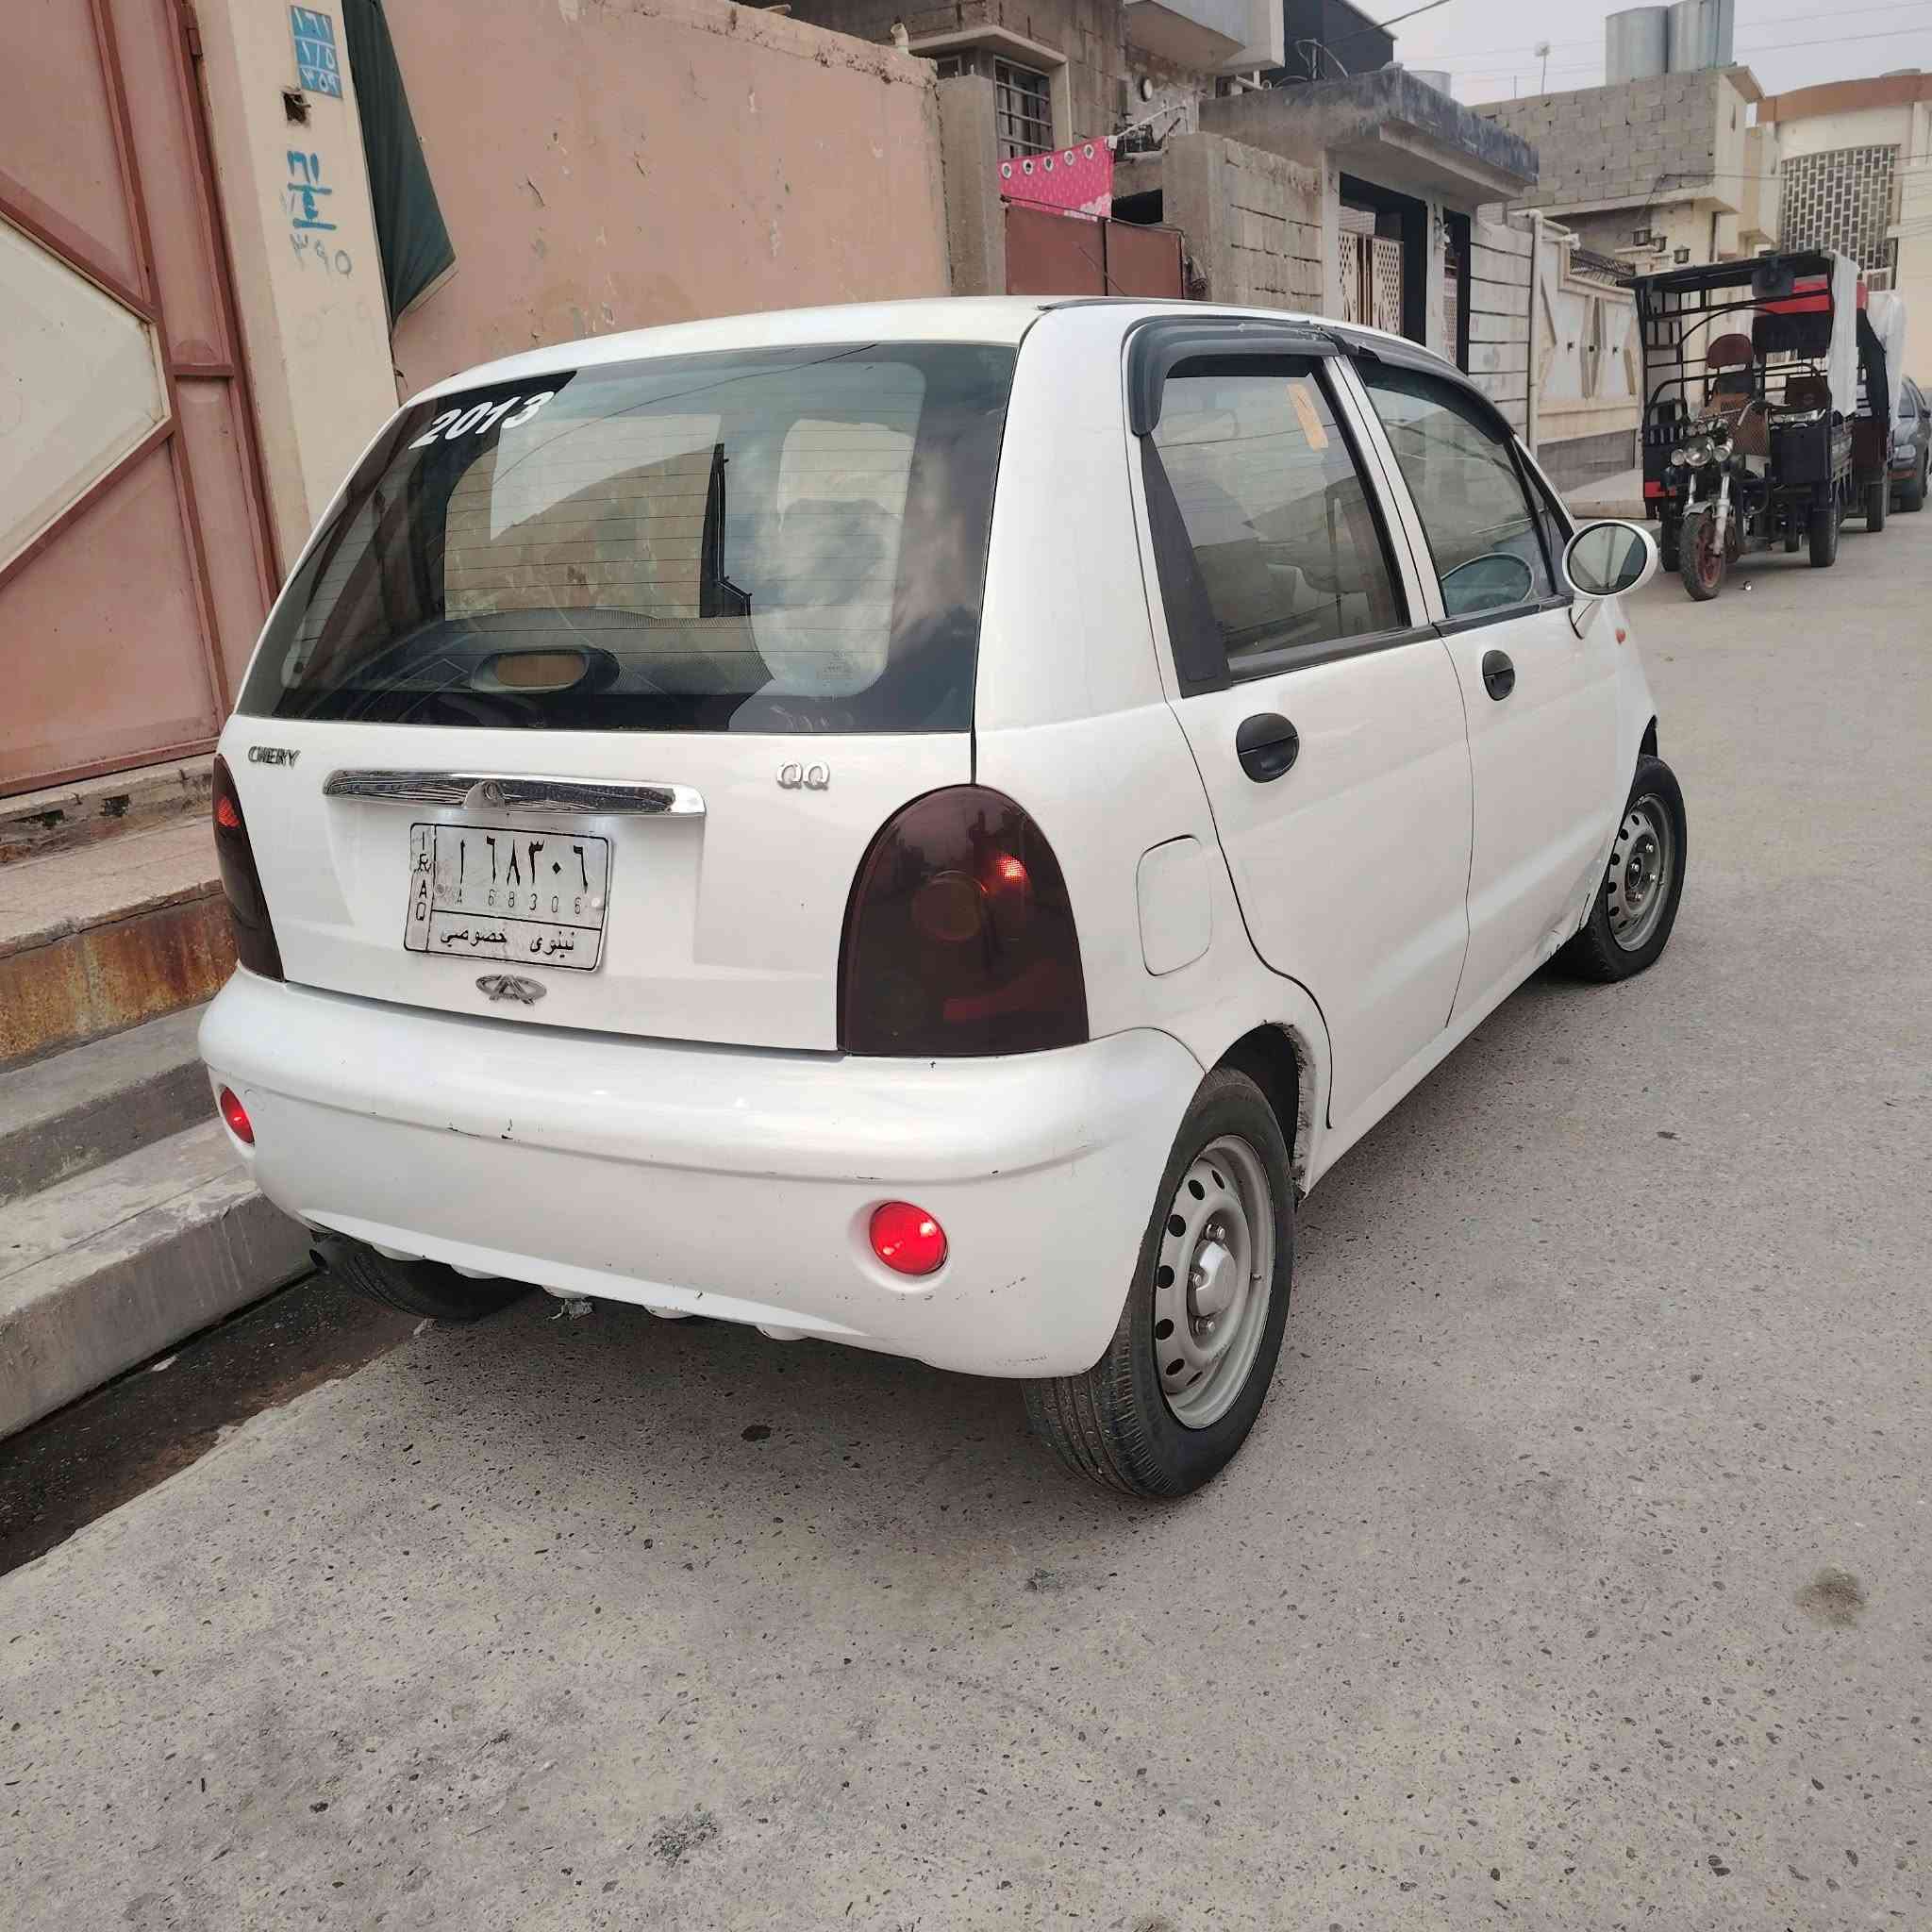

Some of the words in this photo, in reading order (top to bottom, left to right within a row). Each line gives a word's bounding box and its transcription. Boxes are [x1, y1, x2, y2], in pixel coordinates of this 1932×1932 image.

[408, 391, 555, 450] 2013
[247, 745, 301, 769] CHERY
[776, 761, 830, 791] QQ
[414, 831, 432, 922] IRAQ
[440, 926, 508, 947] خصوصي
[529, 930, 575, 958] نينوى
